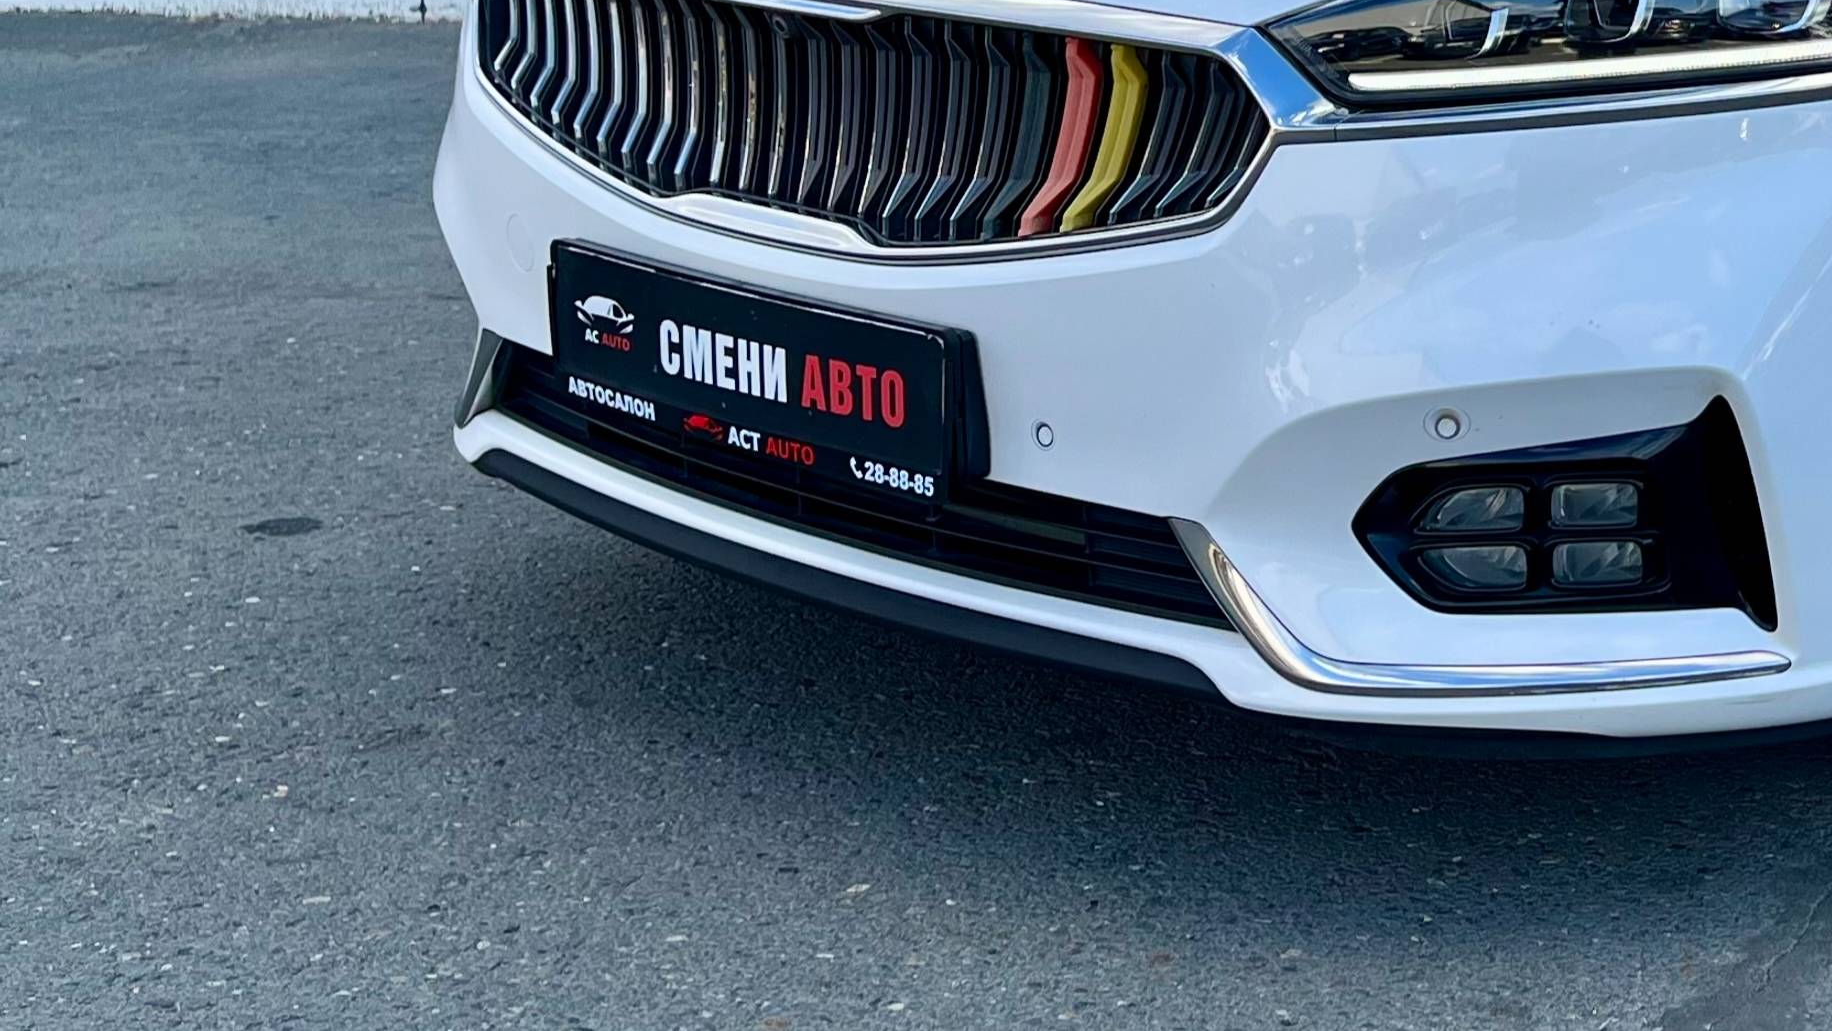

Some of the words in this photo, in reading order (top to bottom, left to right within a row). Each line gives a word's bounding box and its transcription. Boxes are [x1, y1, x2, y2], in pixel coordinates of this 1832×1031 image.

[584, 327, 600, 344] AC
[601, 332, 631, 352] AUTO
[659, 319, 788, 404] СМЕНИ
[801, 353, 906, 428] АВТО
[568, 375, 656, 421] АВТОСАЛОН
[727, 425, 761, 452] ACT
[765, 436, 816, 466] AUTO
[863, 460, 935, 497] 28-88-85
